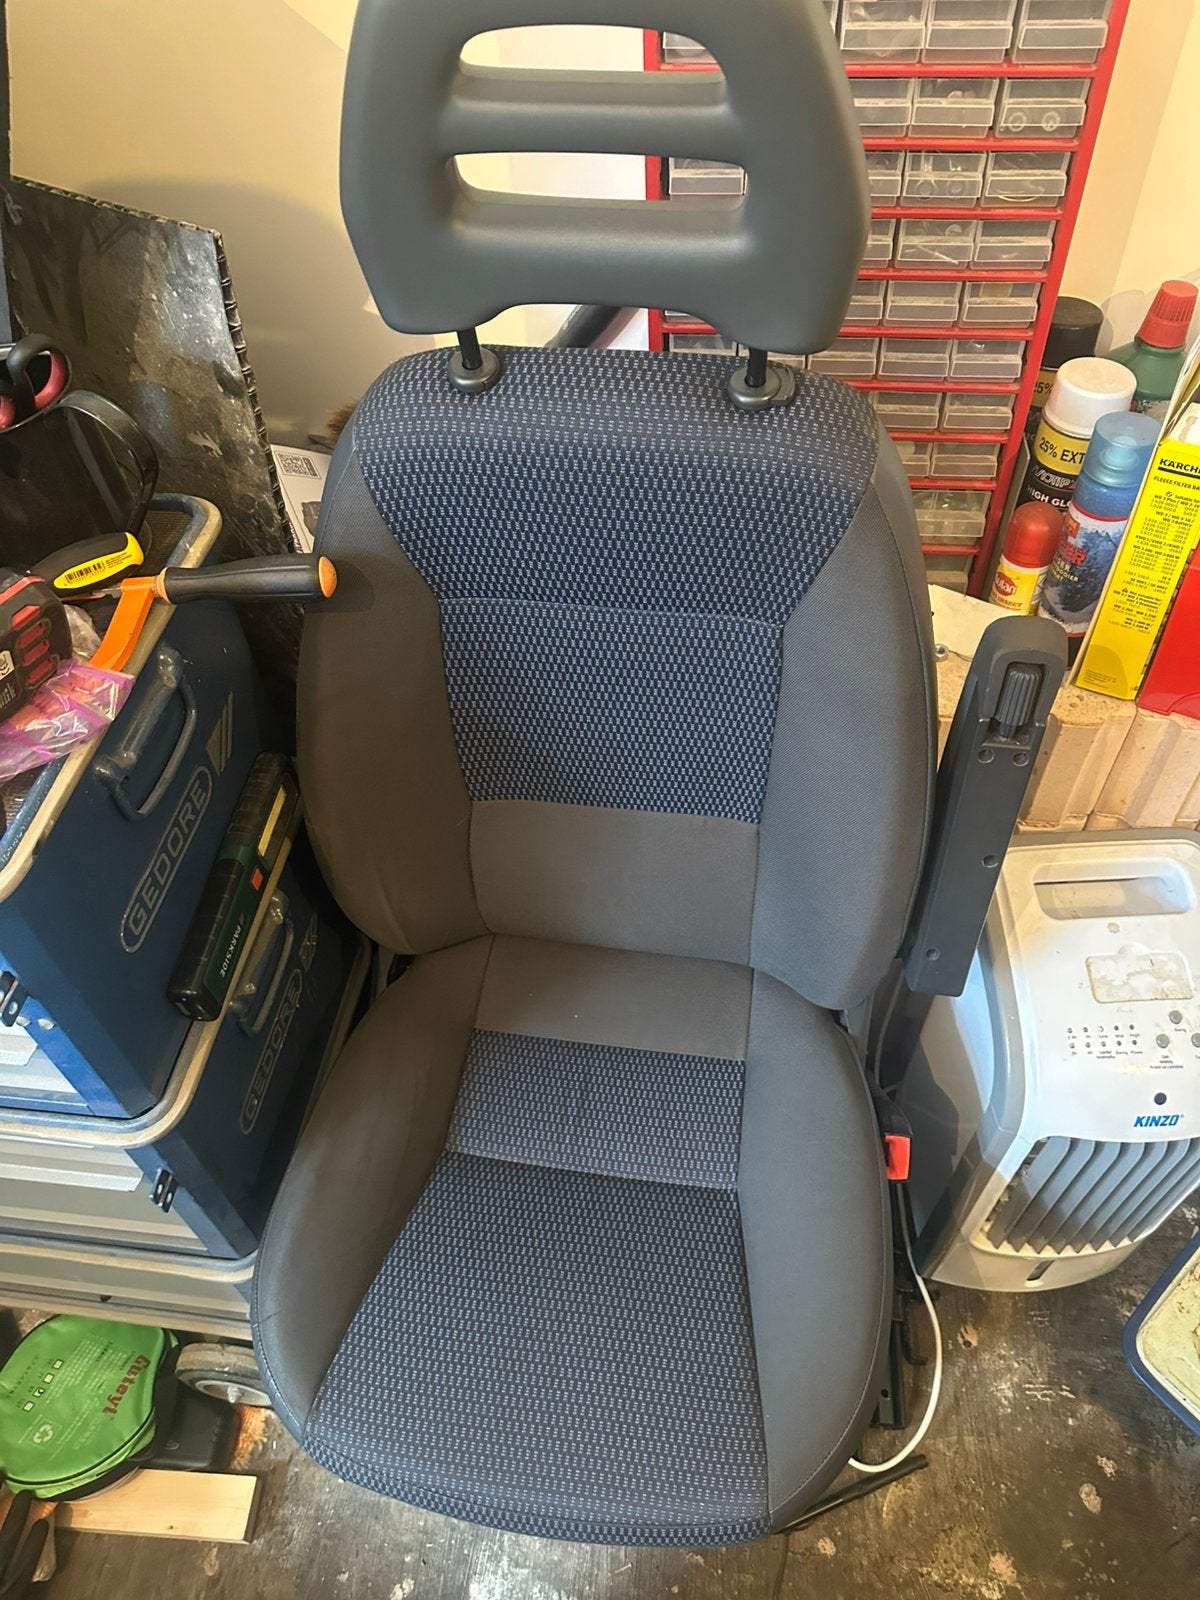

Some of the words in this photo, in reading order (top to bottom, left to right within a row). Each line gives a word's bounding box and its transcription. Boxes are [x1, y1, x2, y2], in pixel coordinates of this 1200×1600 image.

[1040, 437, 1058, 458] 25%
[1060, 449, 1086, 465] EXT
[1028, 484, 1050, 503] HIGH
[128, 780, 206, 935] GEDORE
[220, 924, 242, 978] PARKSIDE
[245, 983, 300, 1119] GEDORE
[1134, 1115, 1180, 1127] KINZO
